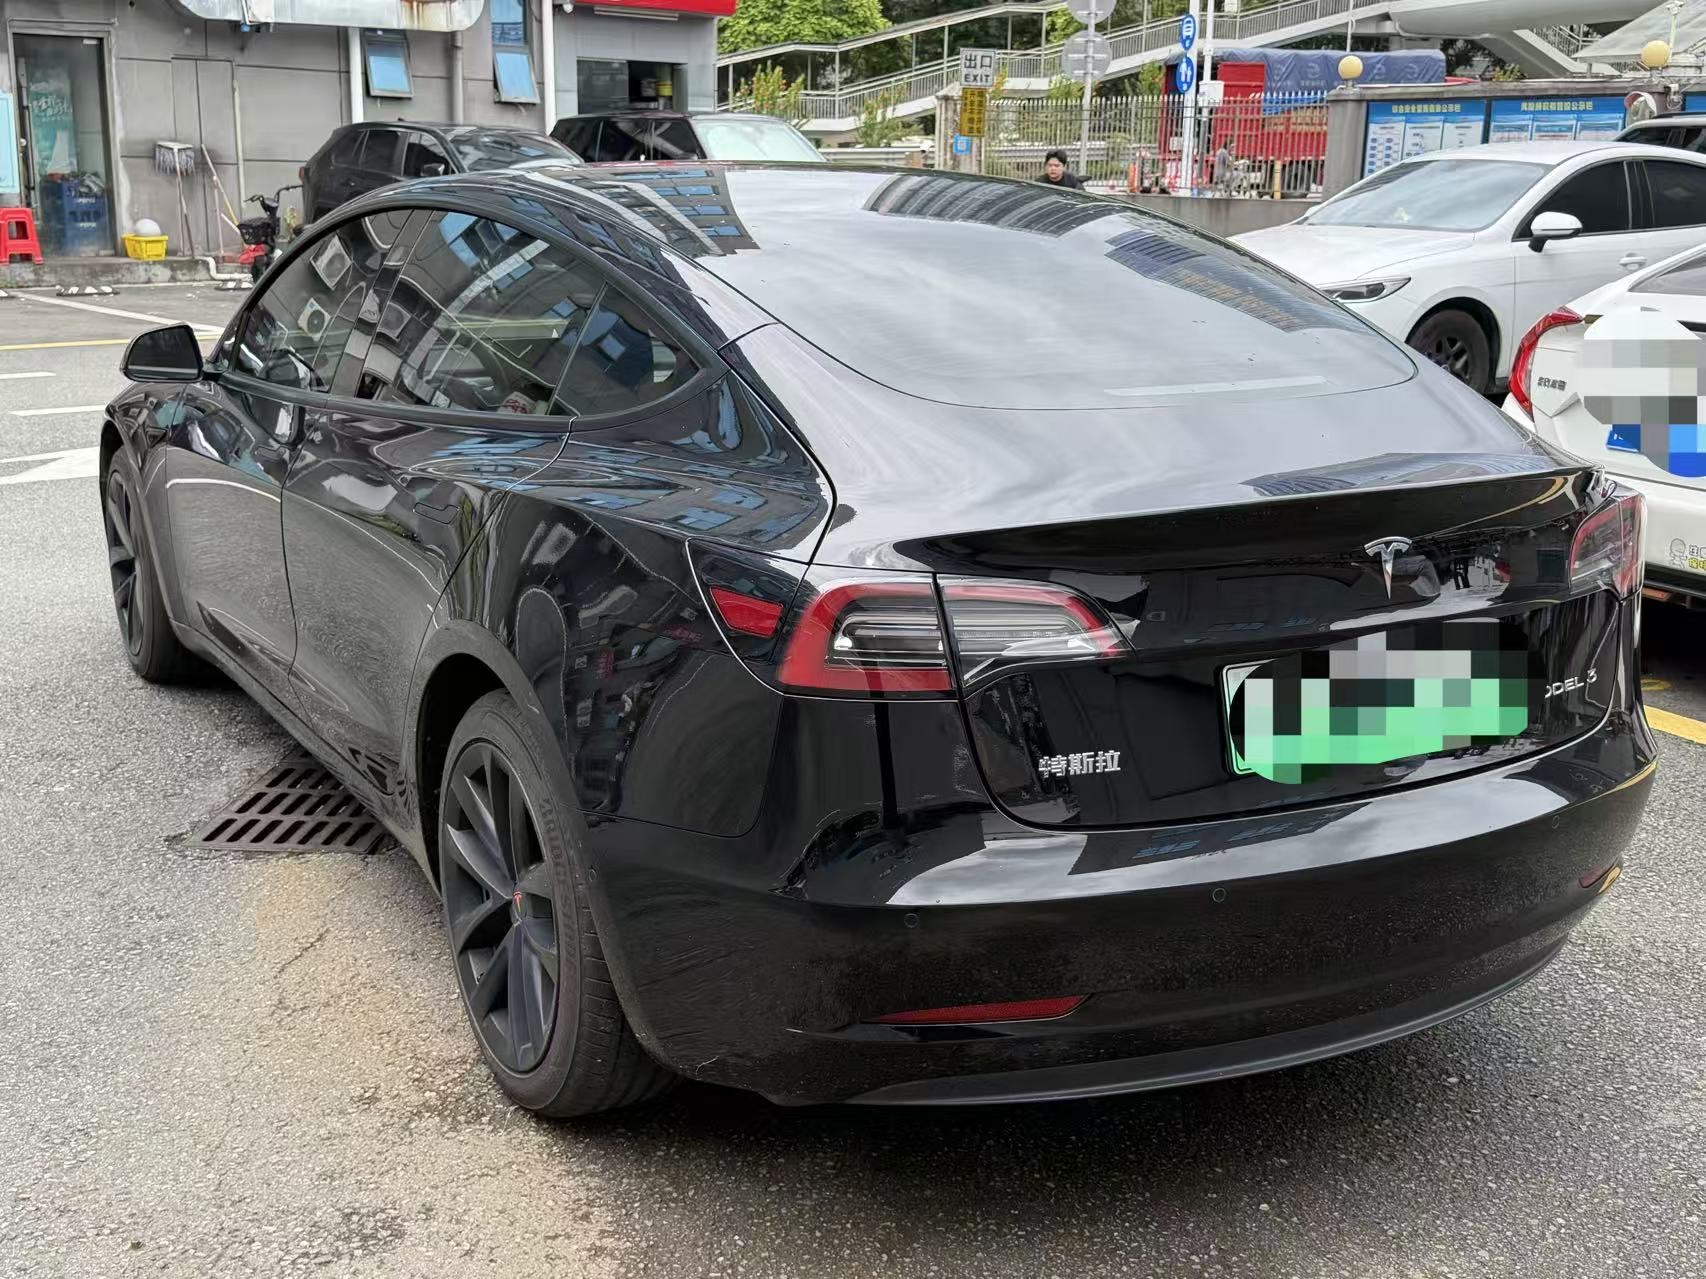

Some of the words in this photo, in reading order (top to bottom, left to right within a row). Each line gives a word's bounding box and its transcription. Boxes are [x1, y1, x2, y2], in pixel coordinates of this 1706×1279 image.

[964, 54, 992, 68] 出口
[965, 74, 990, 82] EXIT
[1545, 676, 1584, 698] ODEL
[1587, 667, 1598, 683] 3
[1038, 750, 1121, 778] 特斯拉
